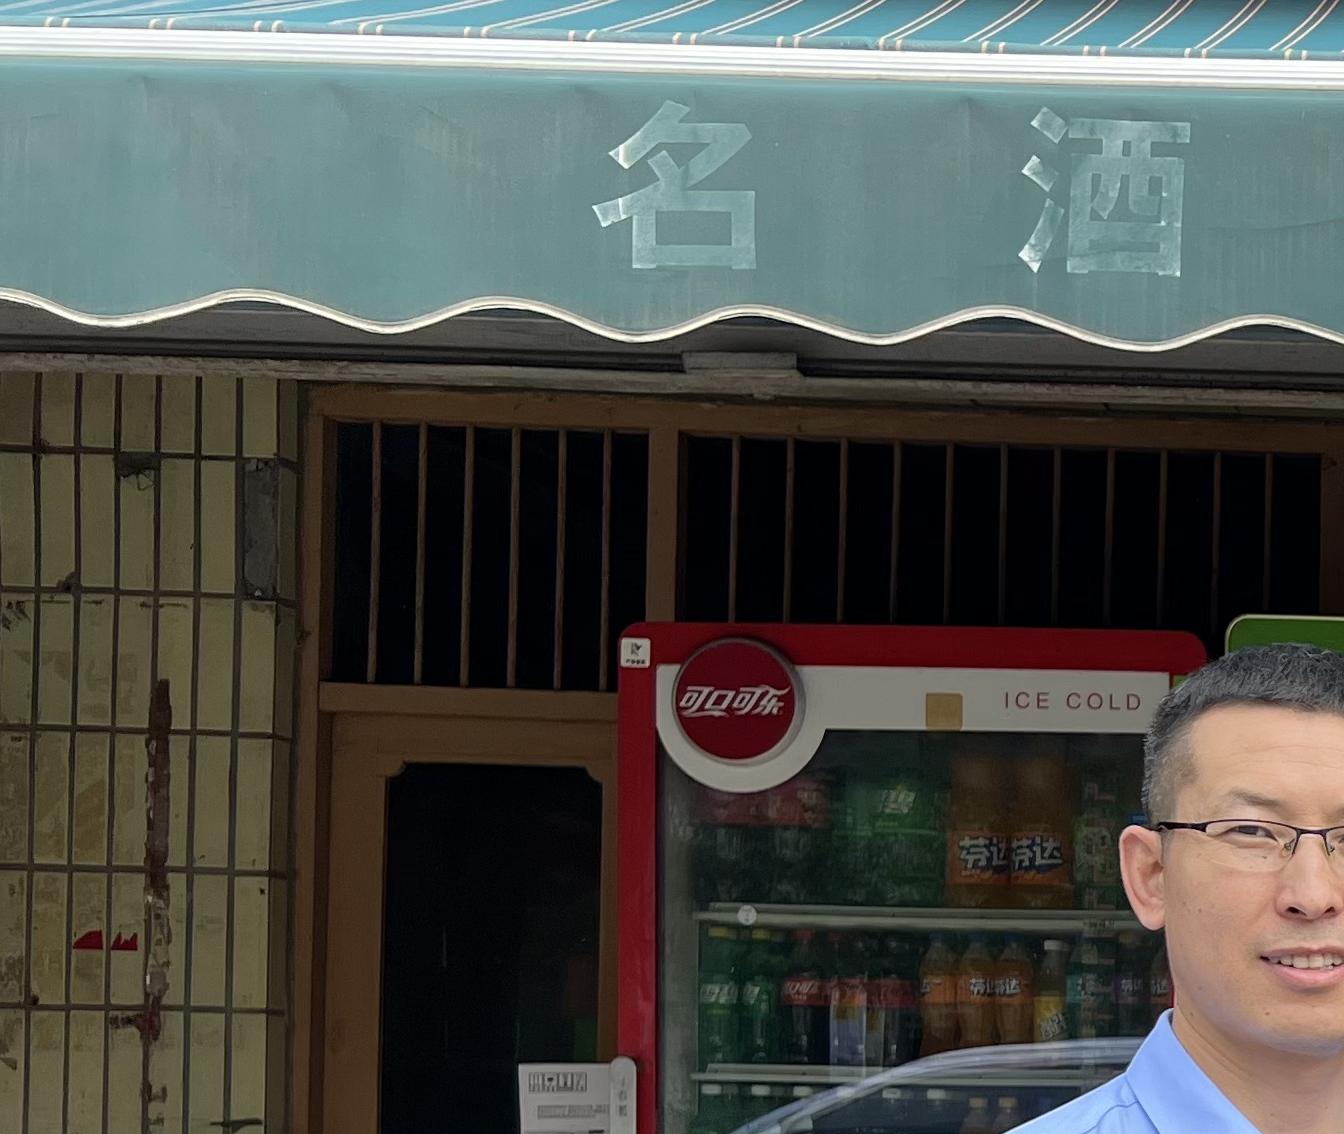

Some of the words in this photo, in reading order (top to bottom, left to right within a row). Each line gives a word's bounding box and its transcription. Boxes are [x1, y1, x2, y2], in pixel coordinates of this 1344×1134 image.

[678, 684, 791, 718] 可口可乐
[1004, 692, 1051, 710] ICE
[1067, 693, 1142, 711] COLD
[1011, 836, 1063, 870] 芬达
